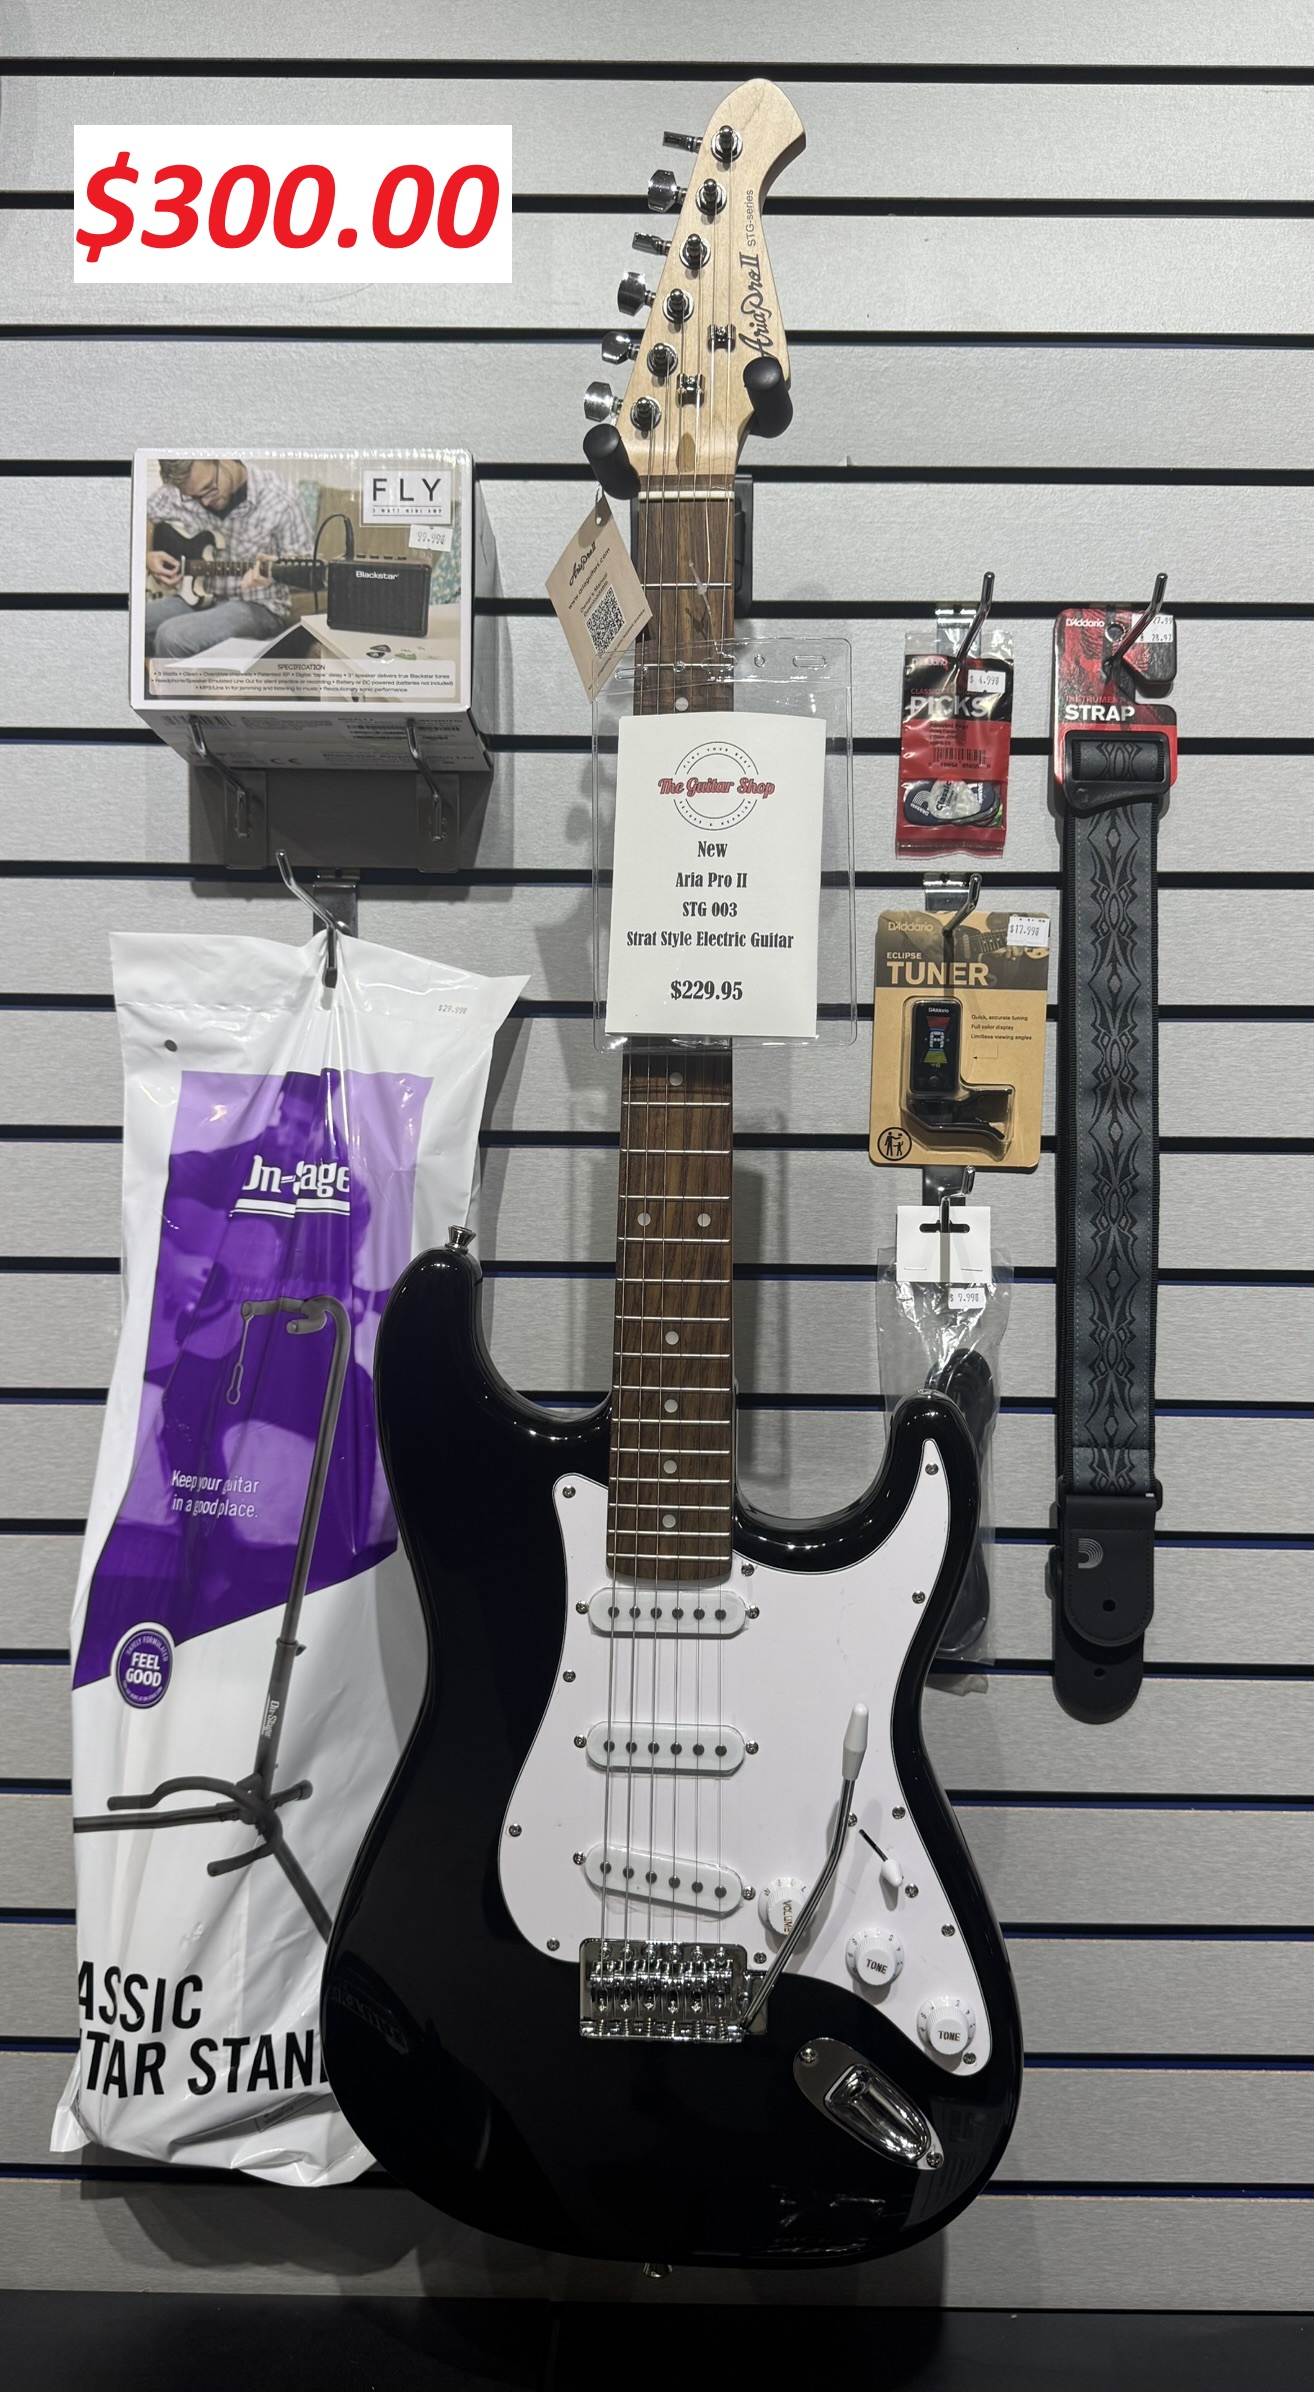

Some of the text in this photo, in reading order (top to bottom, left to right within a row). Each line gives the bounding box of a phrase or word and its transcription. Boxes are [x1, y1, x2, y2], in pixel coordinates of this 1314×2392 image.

[744, 190, 757, 247] STG-series
[373, 478, 442, 502] FLY
[355, 570, 398, 580] Blackstar
[1065, 618, 1105, 627] D'Addario
[910, 696, 986, 718] PICKS
[1065, 704, 1136, 721] STRAP
[658, 777, 776, 800] The Guitar Shop
[697, 841, 728, 858] New
[675, 872, 748, 888] Aria Pro II
[682, 901, 738, 917] STG 003
[887, 921, 934, 932] D'Addario
[626, 931, 795, 949] Strat Style Electric Guitar
[886, 951, 922, 960] ECLIPSE
[886, 961, 990, 986] TUNER
[670, 979, 744, 1001] $229.95
[995, 1024, 1014, 1032] display
[172, 1469, 260, 1495] Keep your guitar
[172, 1494, 258, 1519] in a good place.
[131, 1652, 161, 1670] FEEL
[125, 1668, 162, 1688] GOOD
[783, 1899, 793, 1933] VOLUME
[866, 1958, 888, 1975] TONE
[938, 2030, 961, 2042] TONE
[80, 2028, 329, 2098] TAR STAN
